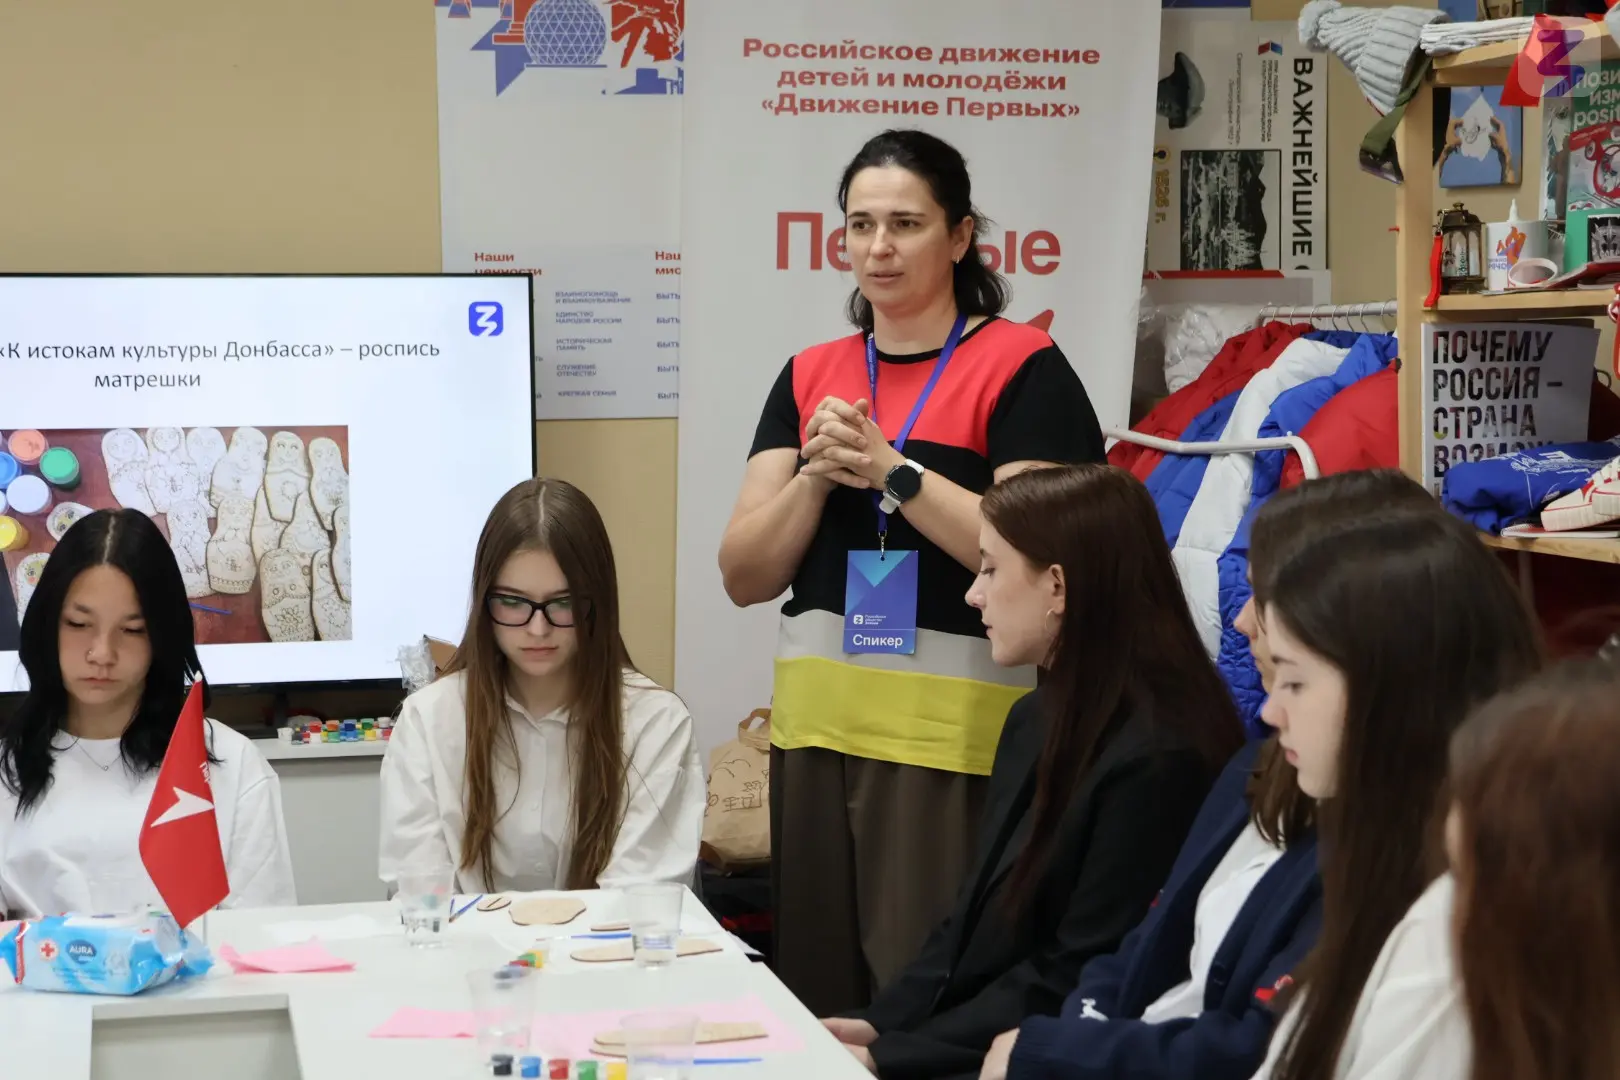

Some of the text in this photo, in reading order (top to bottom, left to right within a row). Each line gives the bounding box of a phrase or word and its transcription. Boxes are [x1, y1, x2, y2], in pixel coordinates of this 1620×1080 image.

[743, 38, 1101, 65] Российское движение
[777, 67, 1067, 92] детей и молодёжи
[762, 93, 1080, 120] «Движение Первых»
[1293, 58, 1318, 256] ВАЖНЕЙШИЕ
[776, 211, 1062, 275] Пеые
[474, 252, 514, 262] Наши
[28, 344, 115, 359] истокам
[122, 344, 217, 363] культуры
[223, 341, 334, 362] Донбасса»
[359, 343, 440, 361] роспись
[1433, 330, 1553, 364] ПОЧЕМУ
[94, 372, 201, 391] матрешки
[1433, 366, 1541, 402] РОССИЯ
[1433, 404, 1537, 440] СТРАНА
[852, 634, 903, 649] Спикер
[69, 945, 94, 956] AURA
